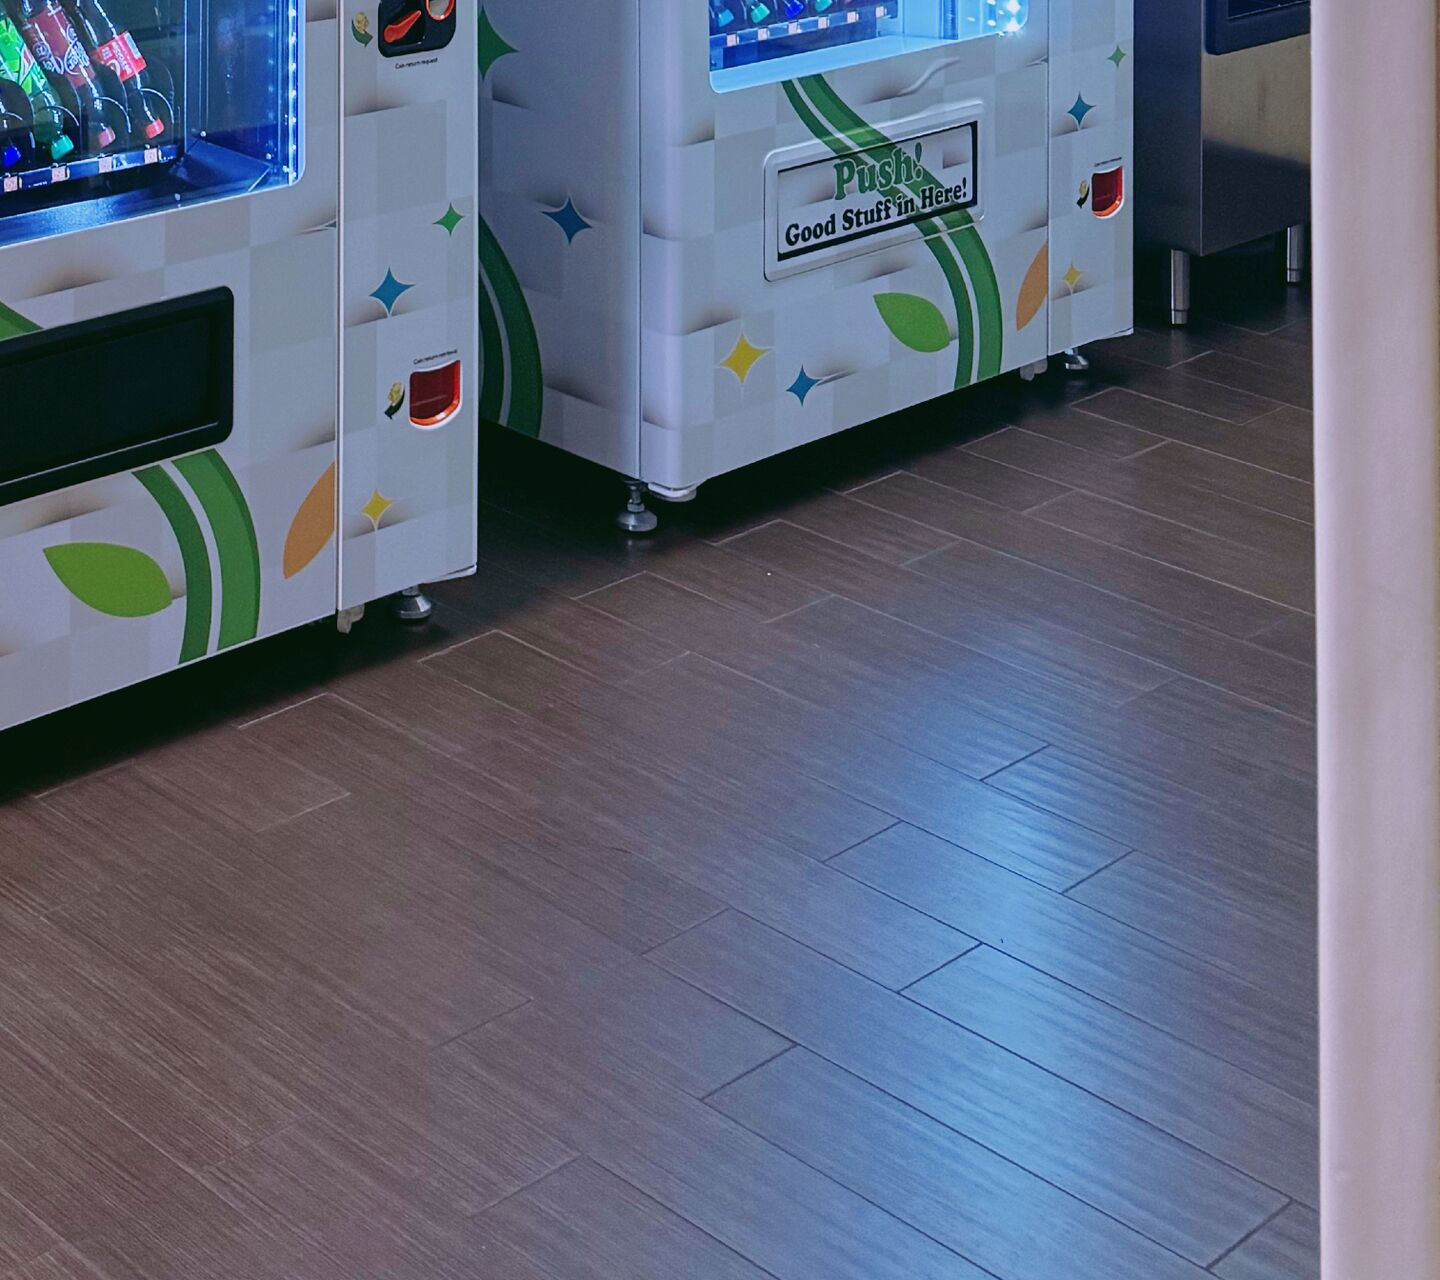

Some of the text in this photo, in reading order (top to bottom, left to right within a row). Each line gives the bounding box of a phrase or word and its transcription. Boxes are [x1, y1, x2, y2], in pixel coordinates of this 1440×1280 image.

[833, 142, 923, 200] Push!
[785, 177, 968, 246] Good Stuff in Here!
